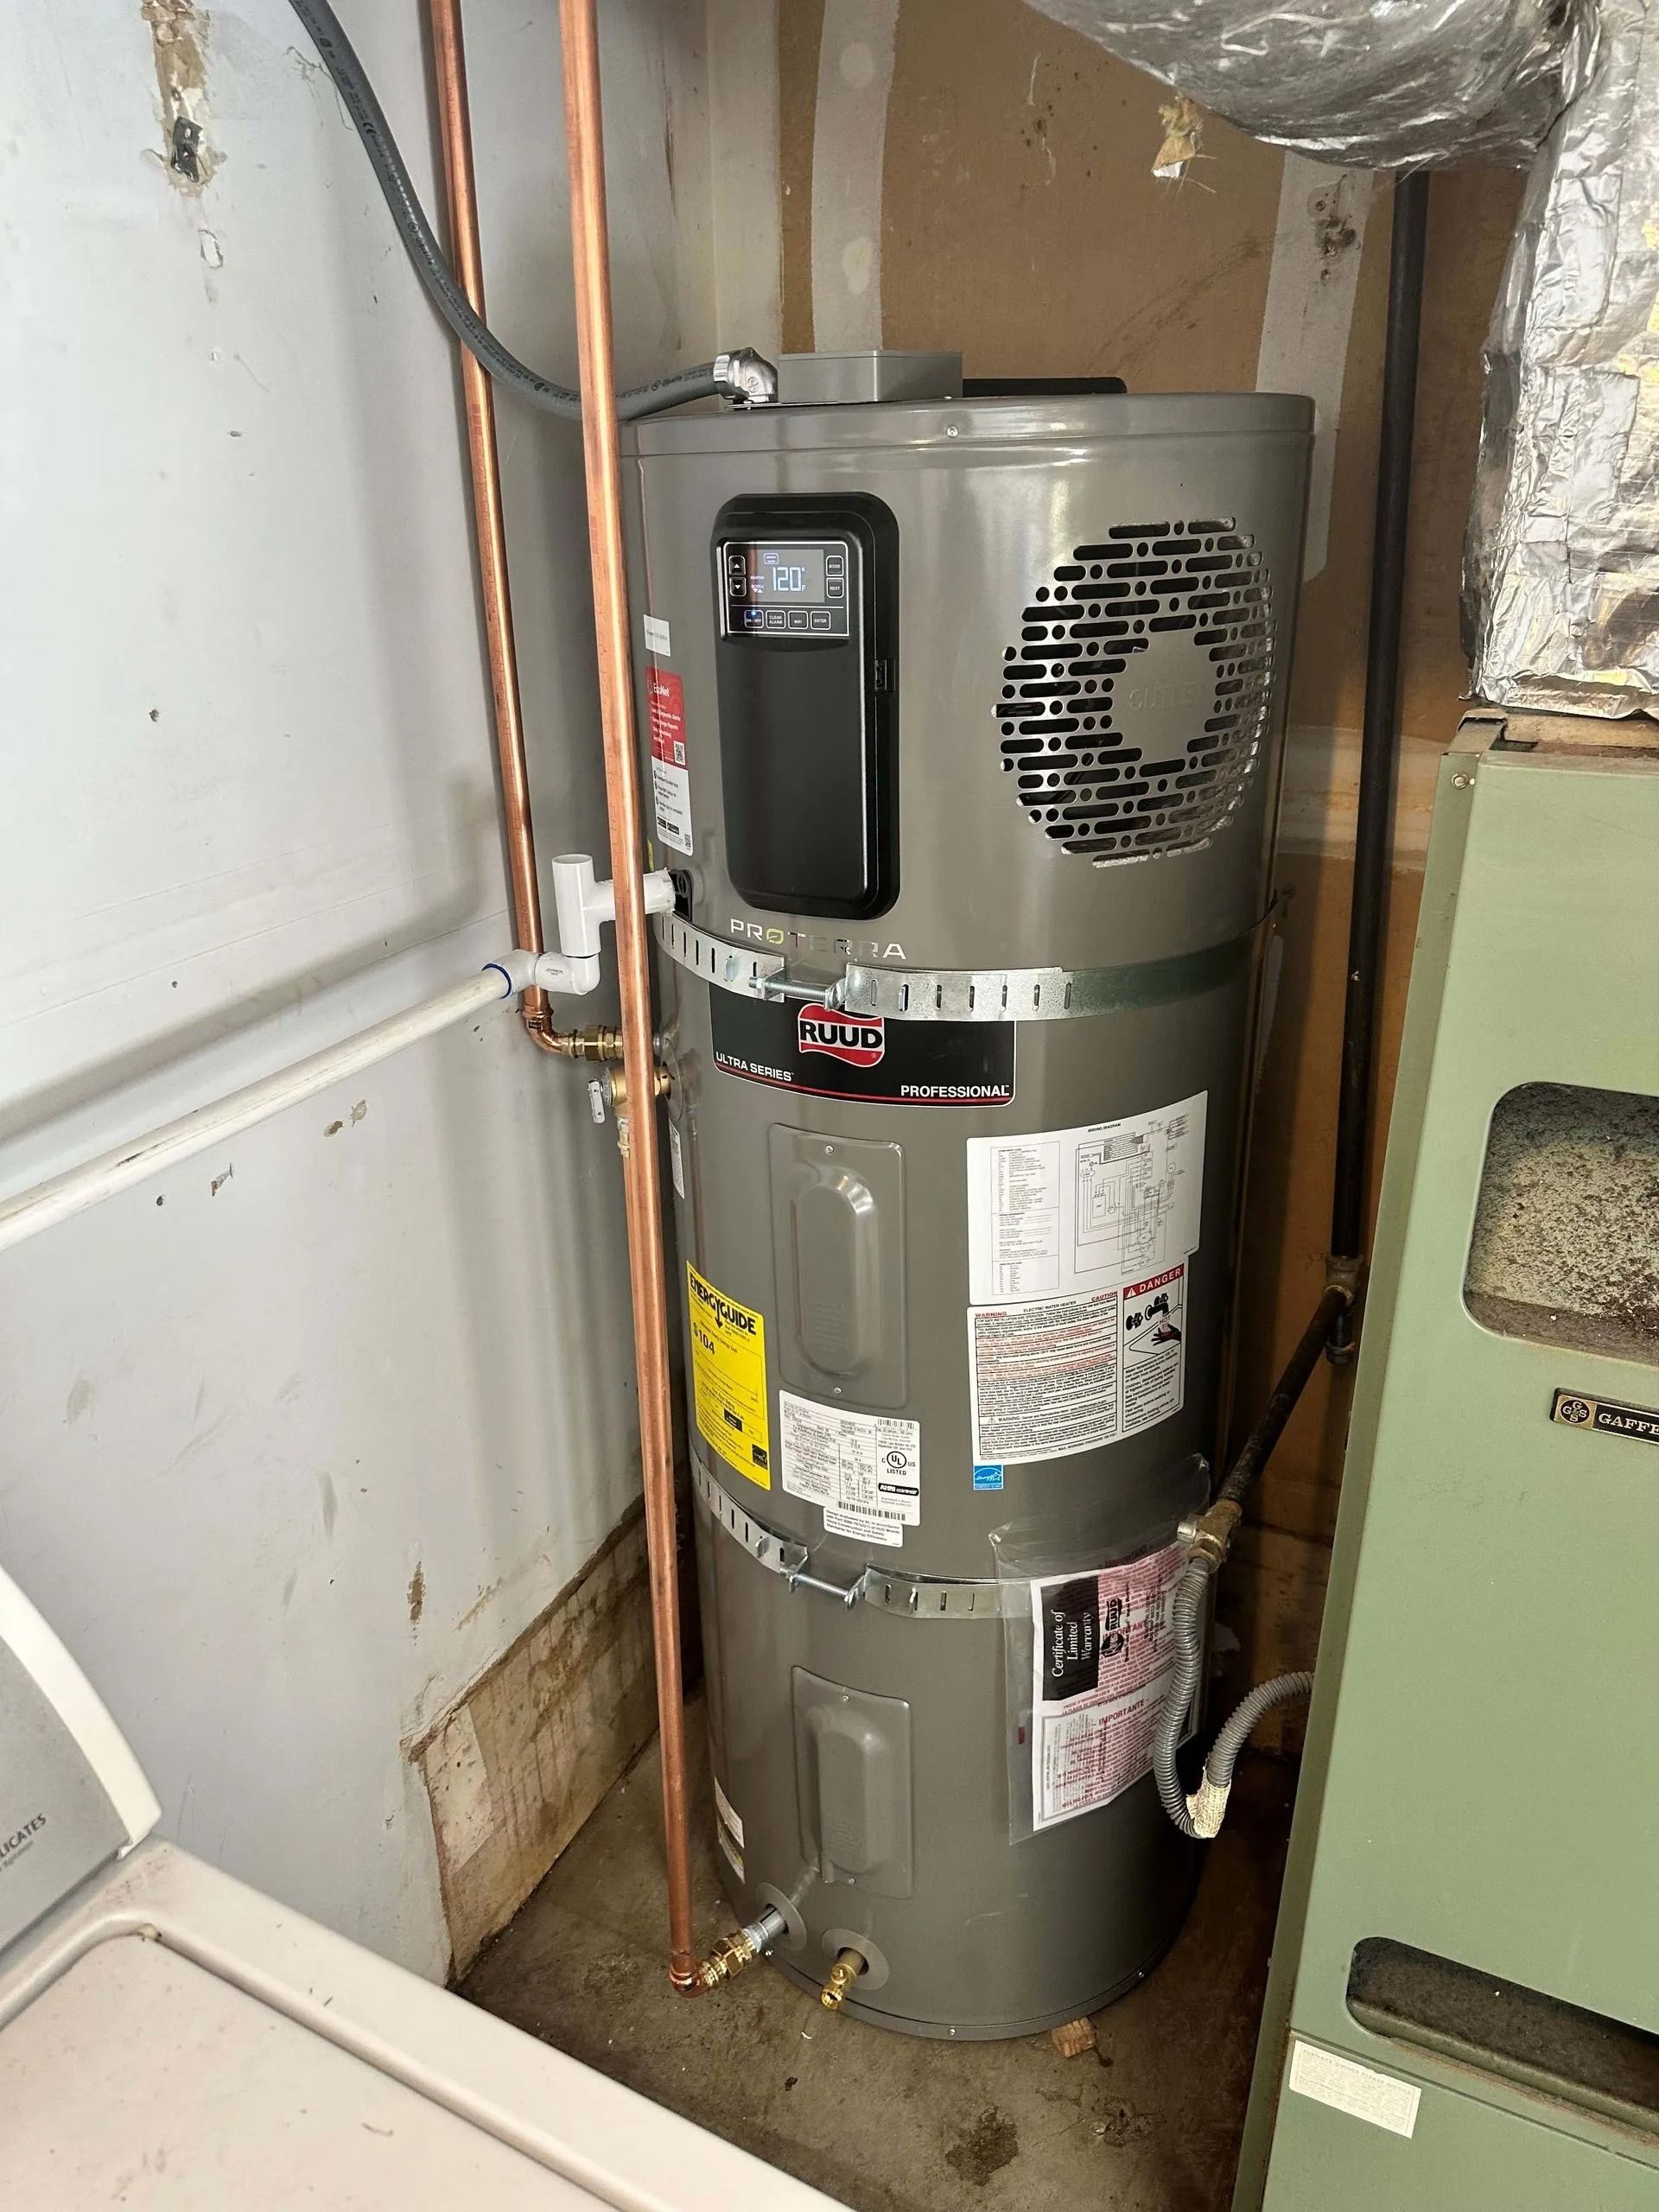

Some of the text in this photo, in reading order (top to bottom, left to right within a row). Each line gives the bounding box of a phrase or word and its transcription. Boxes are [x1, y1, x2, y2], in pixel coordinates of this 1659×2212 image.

[729, 918, 907, 960] PROTERRA
[801, 1020, 884, 1049] RUUD
[715, 1051, 792, 1082] ULTRA SERIES
[1091, 1290, 1118, 1301] CAUTION
[1139, 1268, 1181, 1293] DANGER
[1159, 1316, 1171, 1328] HOT
[693, 1322, 715, 1355] $104
[1109, 1599, 1119, 1630] RUUD
[1051, 1609, 1067, 1678] Certificate of
[1065, 1621, 1078, 1661] Limited
[1081, 1611, 1094, 1661] Warranty
[1098, 1698, 1145, 1726] IMPORTANTE
